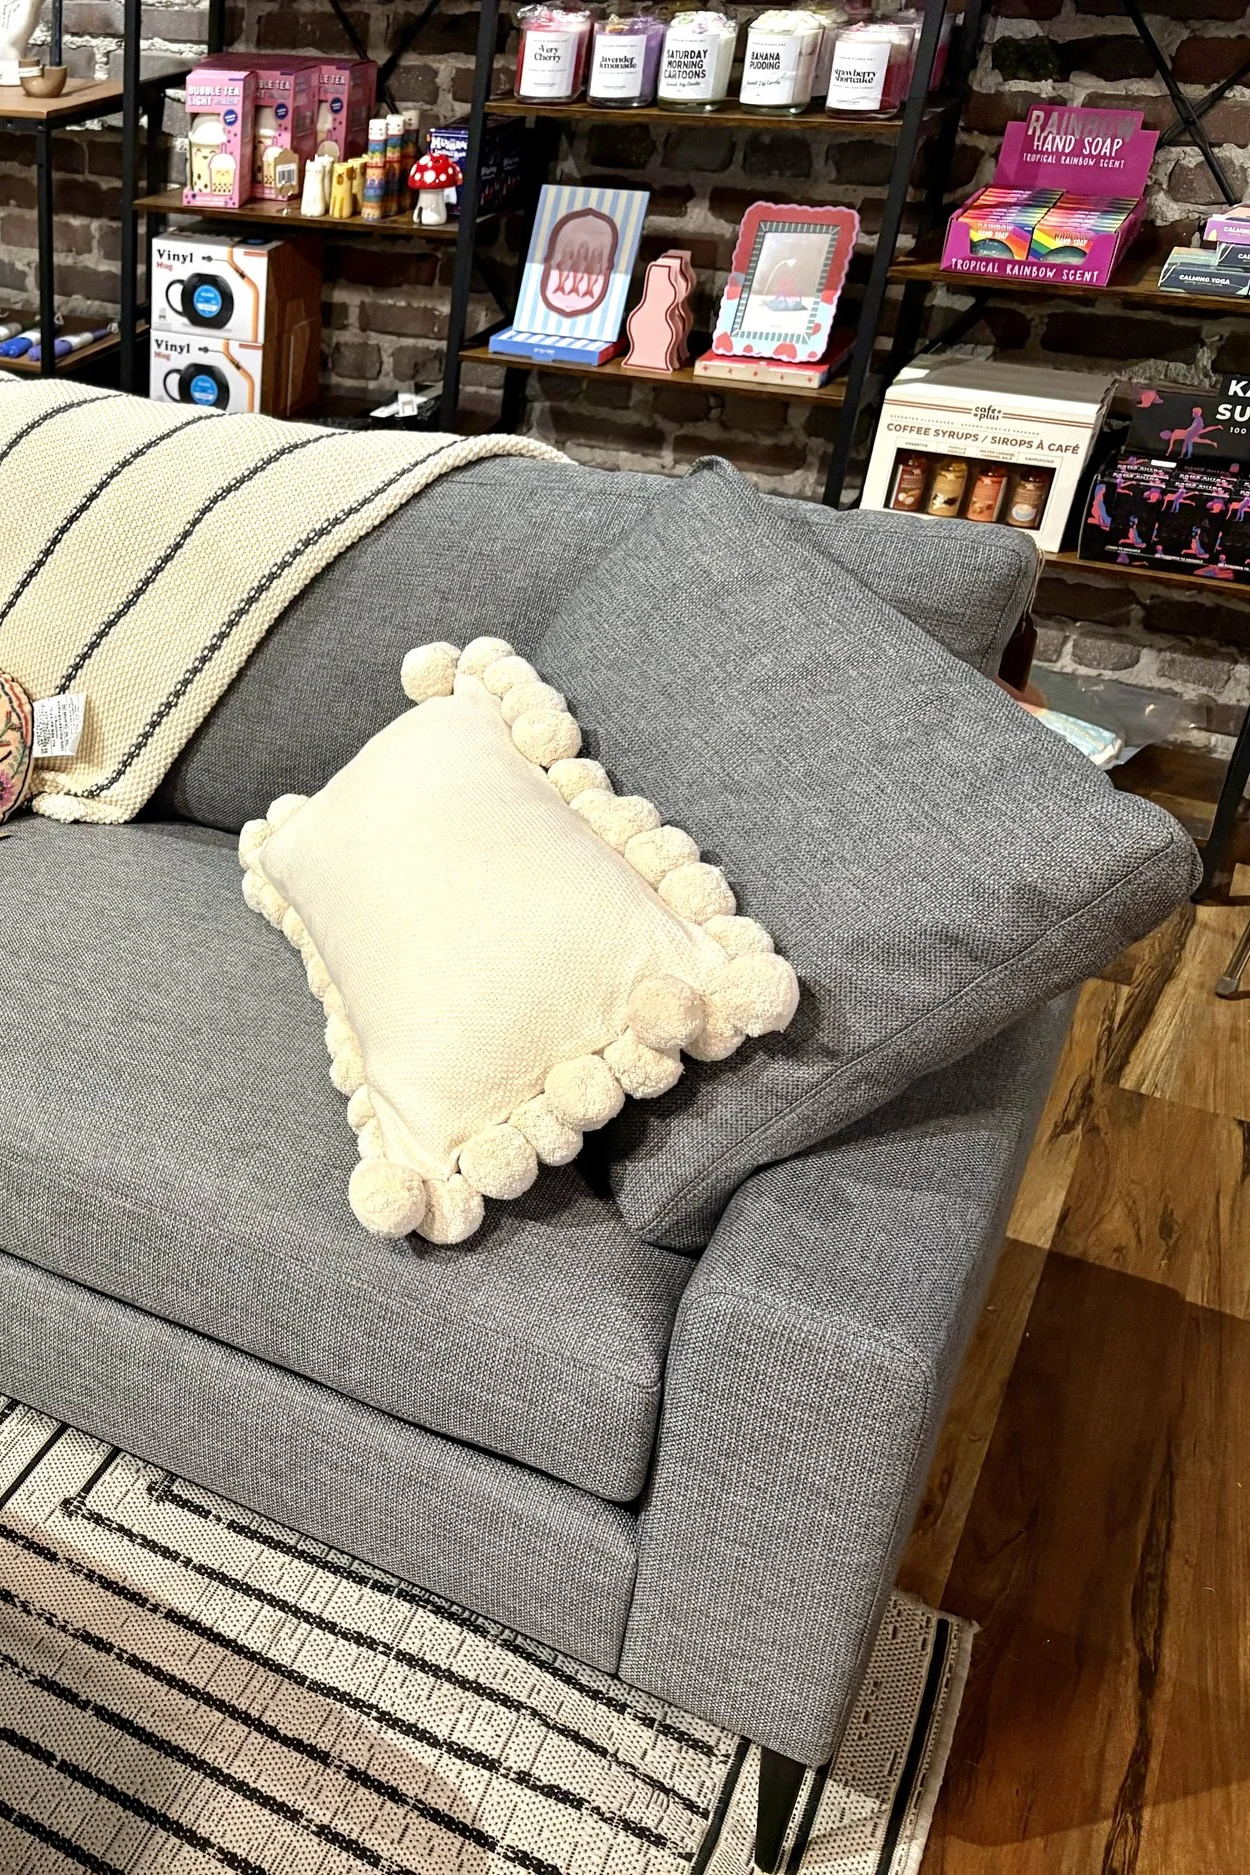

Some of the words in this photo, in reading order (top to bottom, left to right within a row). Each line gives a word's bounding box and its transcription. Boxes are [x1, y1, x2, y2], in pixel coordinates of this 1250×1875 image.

[534, 52, 562, 63] Cherry
[667, 49, 708, 60] SATURDAY
[751, 51, 781, 61] BANANA
[599, 61, 638, 69] lemonade
[667, 60, 704, 69] MORNING
[750, 61, 781, 70] PUDDING
[664, 69, 707, 79] CARTOONS
[275, 80, 291, 90] TEA
[188, 86, 222, 96] BUBBLE
[224, 87, 240, 97] TEA
[188, 97, 213, 106] LIGHT
[1028, 110, 1138, 142] RAINBOW
[1034, 134, 1075, 154] HAND
[1082, 137, 1123, 157] SOAP
[1023, 152, 1056, 164] TROPICAL
[1061, 156, 1096, 166] RAINBOW
[1099, 159, 1125, 168] SCENT
[157, 249, 193, 264] Vinyl
[951, 258, 999, 273] TROPICAL
[1006, 264, 1056, 278] RAINBOW
[1062, 270, 1099, 283] SCENT
[1179, 274, 1210, 283] CALMING
[1211, 277, 1230, 285] YOGA
[154, 339, 190, 354] Vinyl
[887, 423, 931, 436] COFFEE
[933, 428, 980, 442] SYRUPS
[990, 436, 1034, 449] SIROPS
[1036, 439, 1044, 450] À
[1048, 443, 1080, 455] CAFÉ
